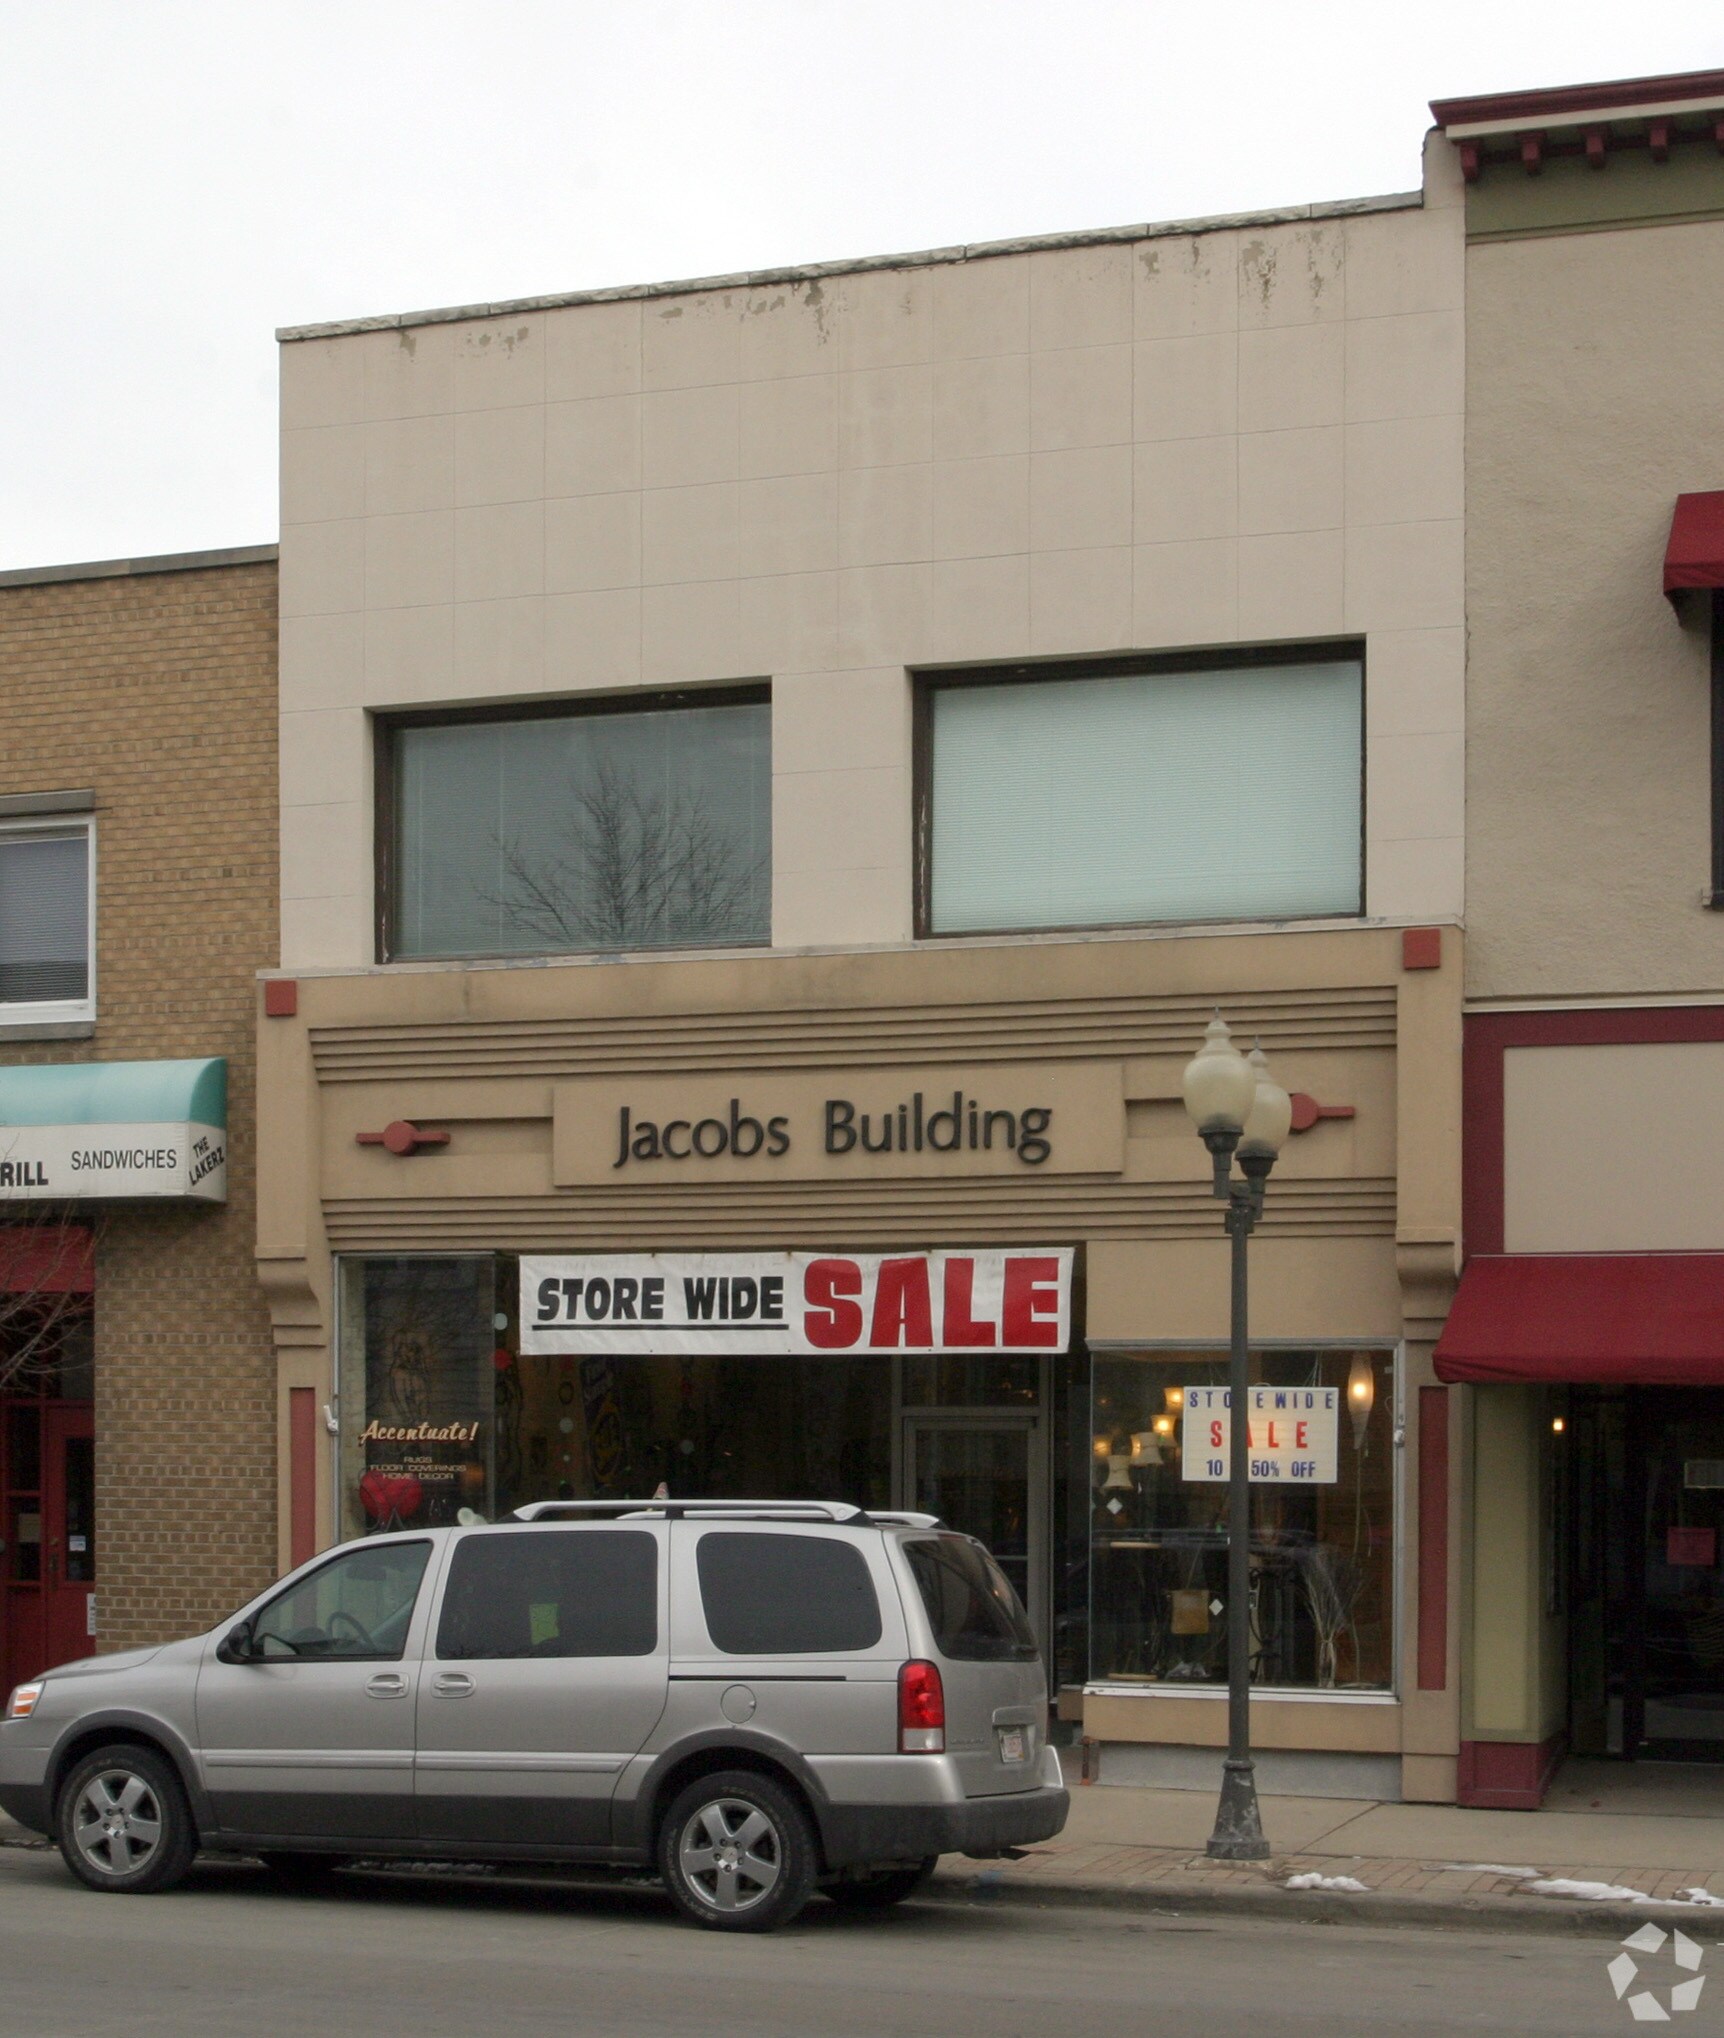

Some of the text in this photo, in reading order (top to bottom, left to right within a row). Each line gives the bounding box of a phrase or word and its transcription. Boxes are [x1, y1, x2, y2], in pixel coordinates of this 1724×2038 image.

[612, 1091, 1053, 1169] Jacobs Building
[193, 1136, 209, 1158] THE
[71, 1149, 177, 1170] SANDWICHES
[189, 1146, 225, 1186] LAKERZ
[537, 1257, 1059, 1349] STORE WIDE SALE
[1190, 1391, 1332, 1409] STOEWIDE
[358, 1420, 479, 1447] Accentuate!
[370, 1464, 466, 1472] FLOOR COVERINGS
[419, 1472, 454, 1480] DECOR
[1251, 1460, 1279, 1477] 50%
[1291, 1461, 1316, 1477] OFF
